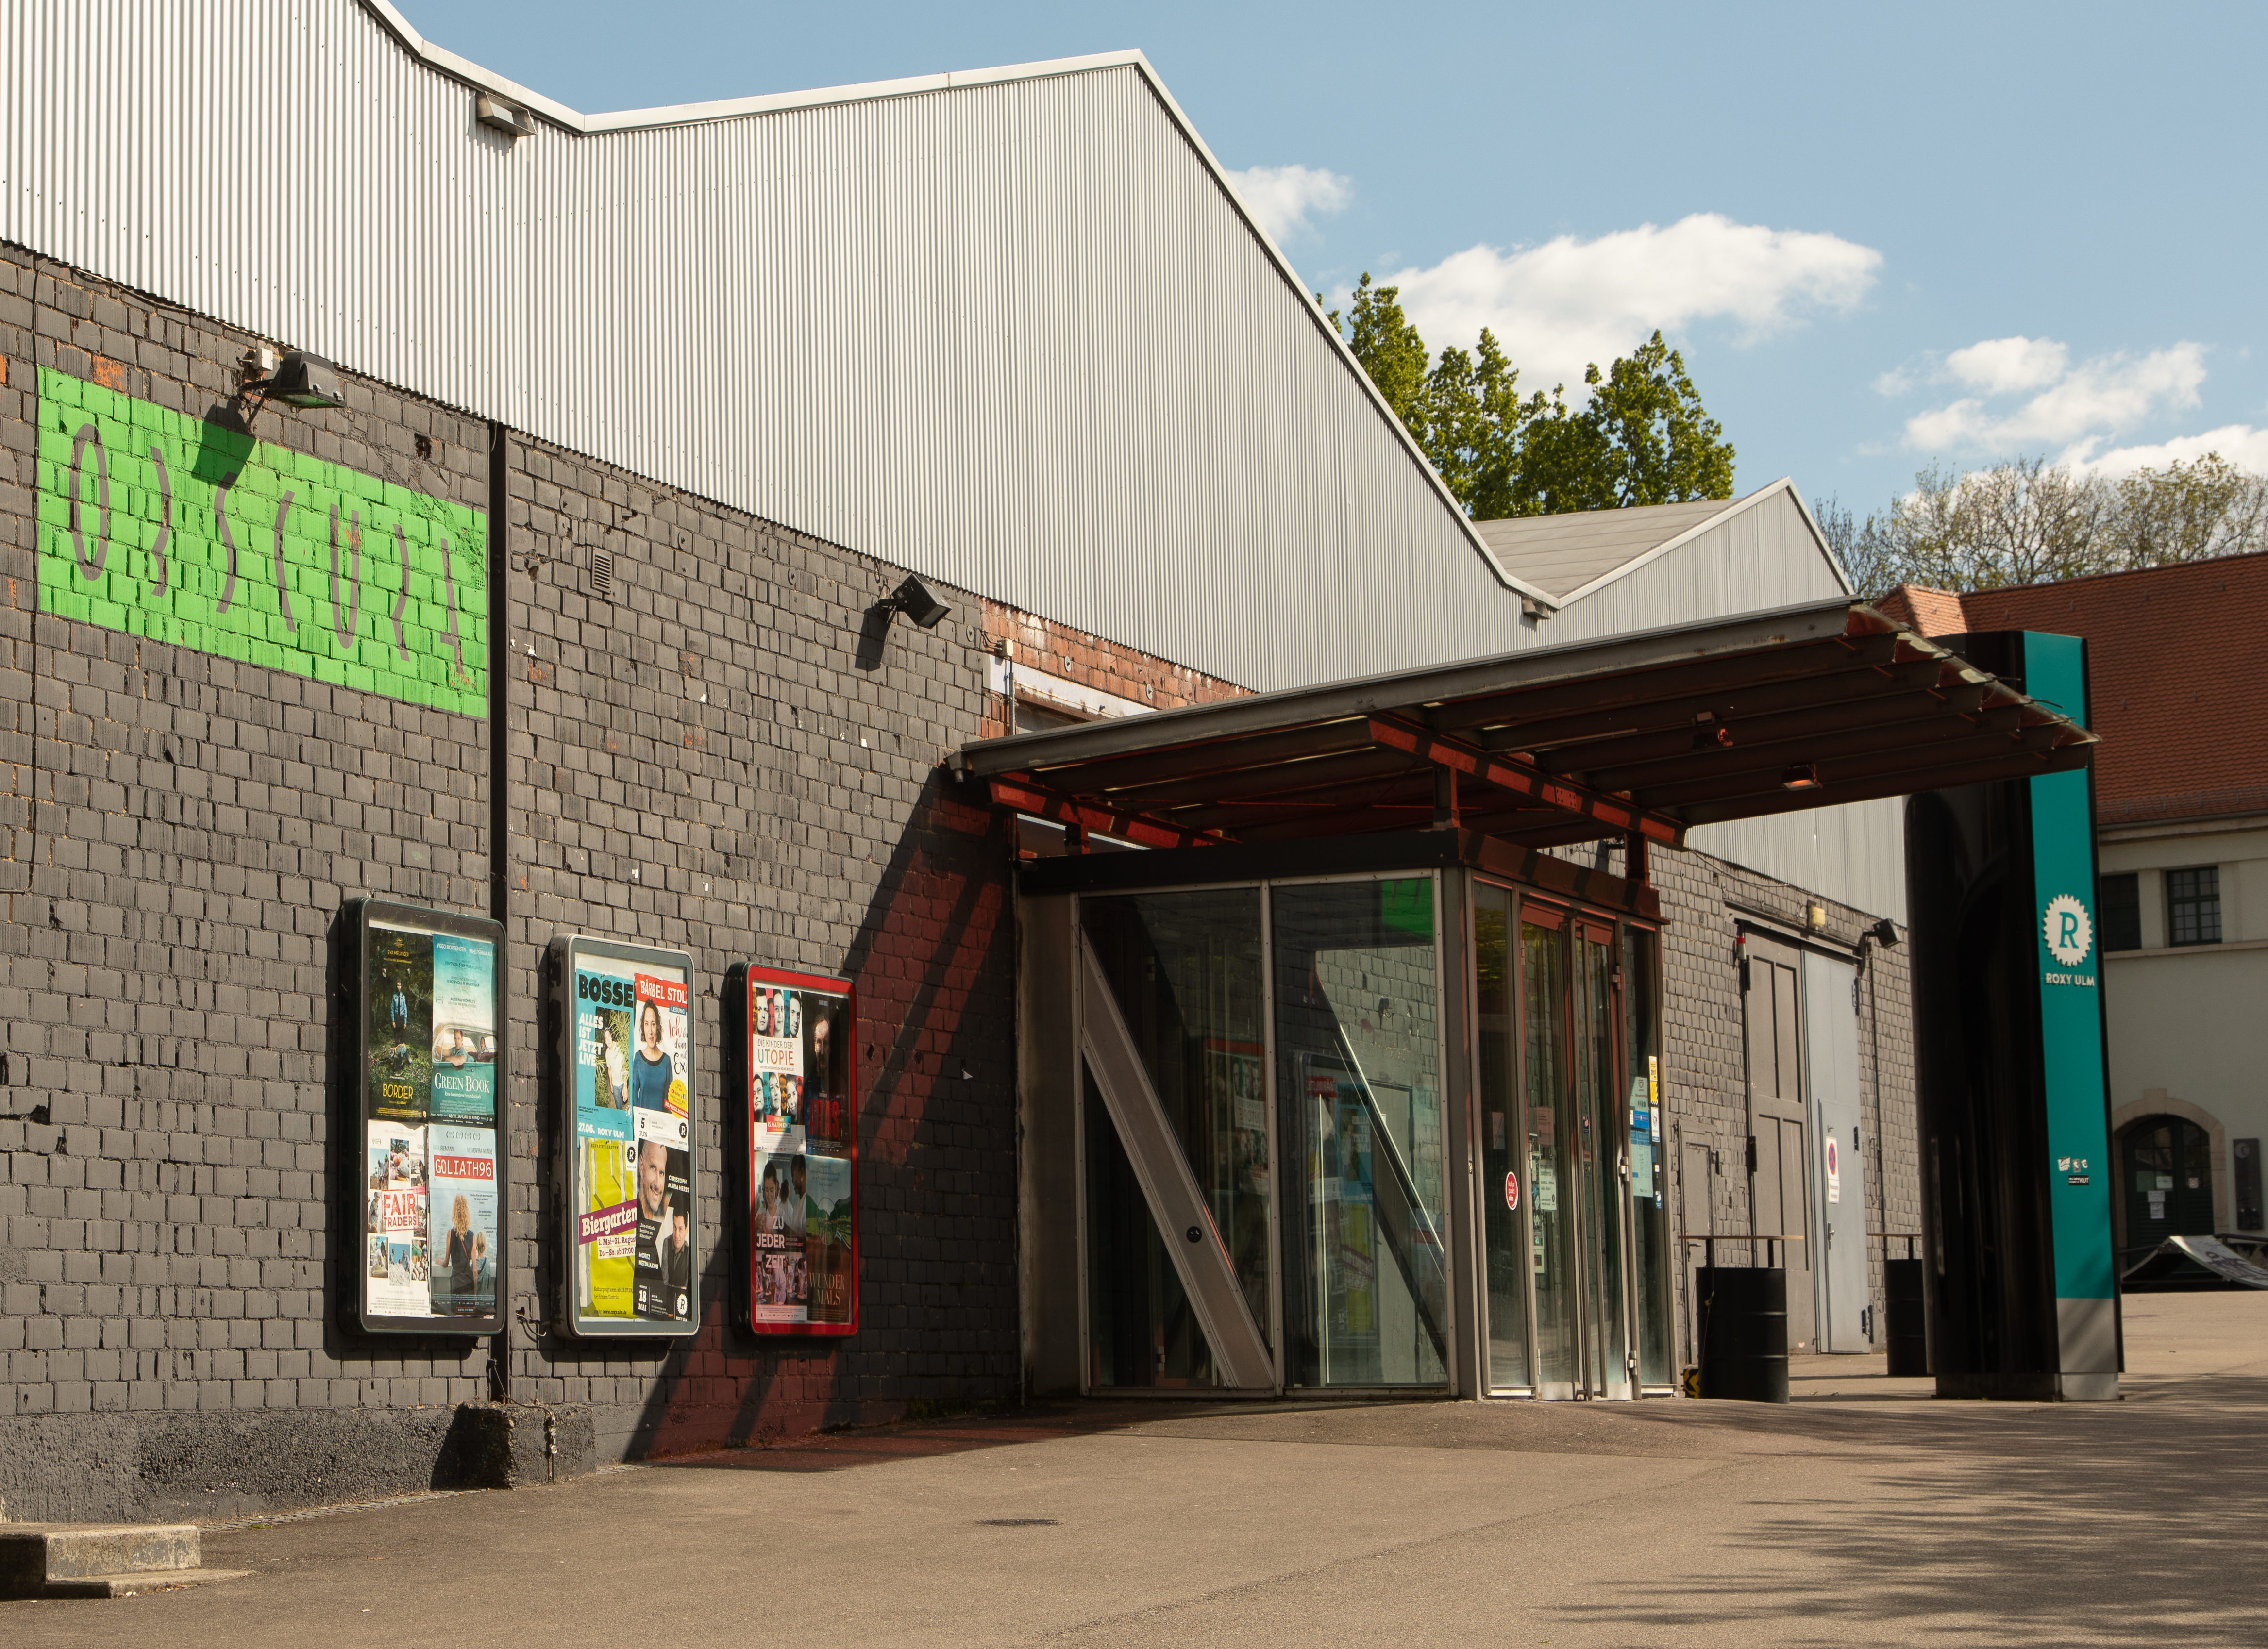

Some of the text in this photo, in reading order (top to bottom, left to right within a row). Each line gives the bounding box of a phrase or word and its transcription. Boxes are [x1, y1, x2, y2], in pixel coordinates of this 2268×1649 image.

[2059, 911, 2079, 949] R
[446, 944, 466, 952] MORTENSEN
[2045, 972, 2095, 987] ROXY ULM
[578, 974, 634, 1008] BOSSE
[640, 978, 688, 1005] BÄRBEL STOL
[578, 1012, 604, 1030] ALLES
[669, 1015, 682, 1038] Ich
[578, 1025, 592, 1039] IST
[578, 1038, 604, 1055] JETZT
[766, 1040, 783, 1048] KINDER
[579, 1051, 596, 1067] LIVE
[758, 1049, 794, 1066] UTOPIE
[434, 1072, 490, 1093] GREEN BOOK
[383, 1083, 413, 1099] BORDER
[641, 1117, 645, 1129] 5
[809, 1099, 839, 1138] ATLAS
[578, 1122, 624, 1138] 27.06. ROXY ULM
[681, 1125, 686, 1136] R
[629, 1149, 634, 1160] R
[435, 1158, 492, 1177] GOLIATH96
[668, 1175, 687, 1185] CHRISTOPH
[668, 1182, 690, 1193] MARIA HERBS
[383, 1193, 416, 1216] FAIR
[384, 1216, 417, 1227] TRADERS
[581, 1207, 637, 1237] Biergarten
[773, 1215, 784, 1230] ZU
[622, 1236, 636, 1245] Augus
[756, 1233, 785, 1249] JEDER
[765, 1254, 786, 1268] ZEIT
[809, 1272, 845, 1290] WUNDER
[638, 1290, 647, 1303] 18
[680, 1299, 685, 1310] R
[816, 1289, 840, 1306] MALS
[638, 1303, 647, 1312] MAI
